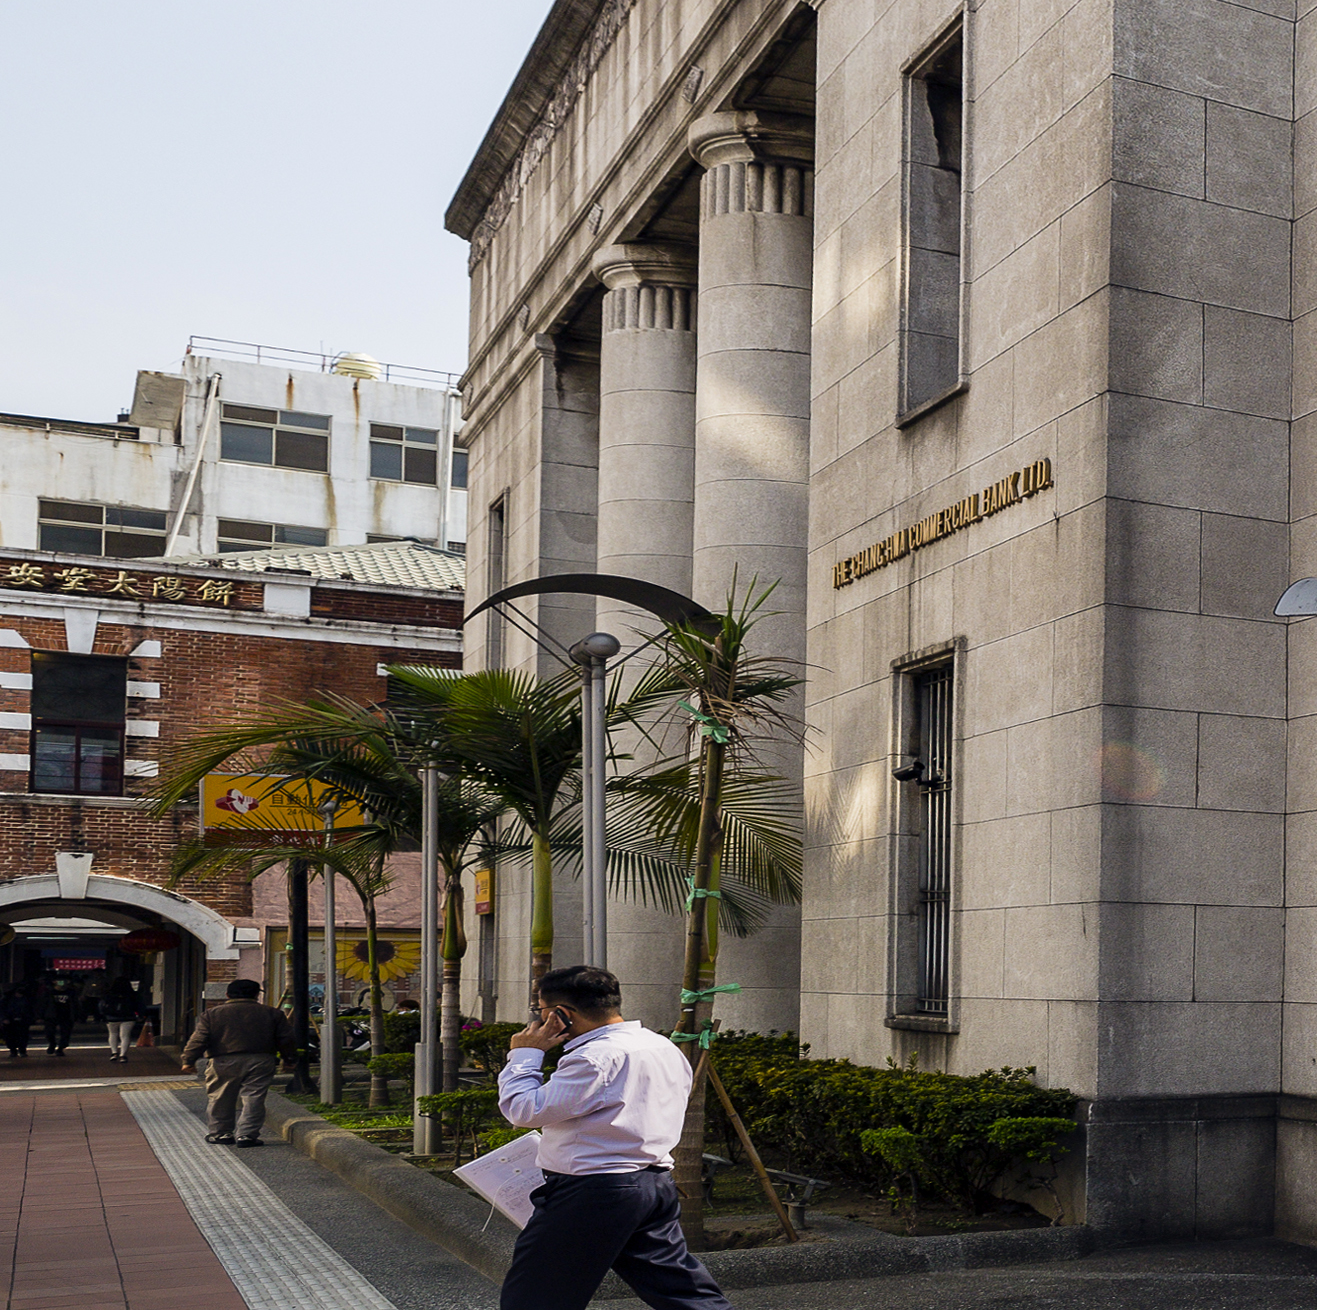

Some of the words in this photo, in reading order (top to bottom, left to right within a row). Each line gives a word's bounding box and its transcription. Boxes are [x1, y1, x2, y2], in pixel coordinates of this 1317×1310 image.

[831, 558, 853, 590] THE
[851, 541, 886, 579] CHANG
[884, 527, 910, 563] HWA
[907, 493, 983, 551] COMMERCIAL
